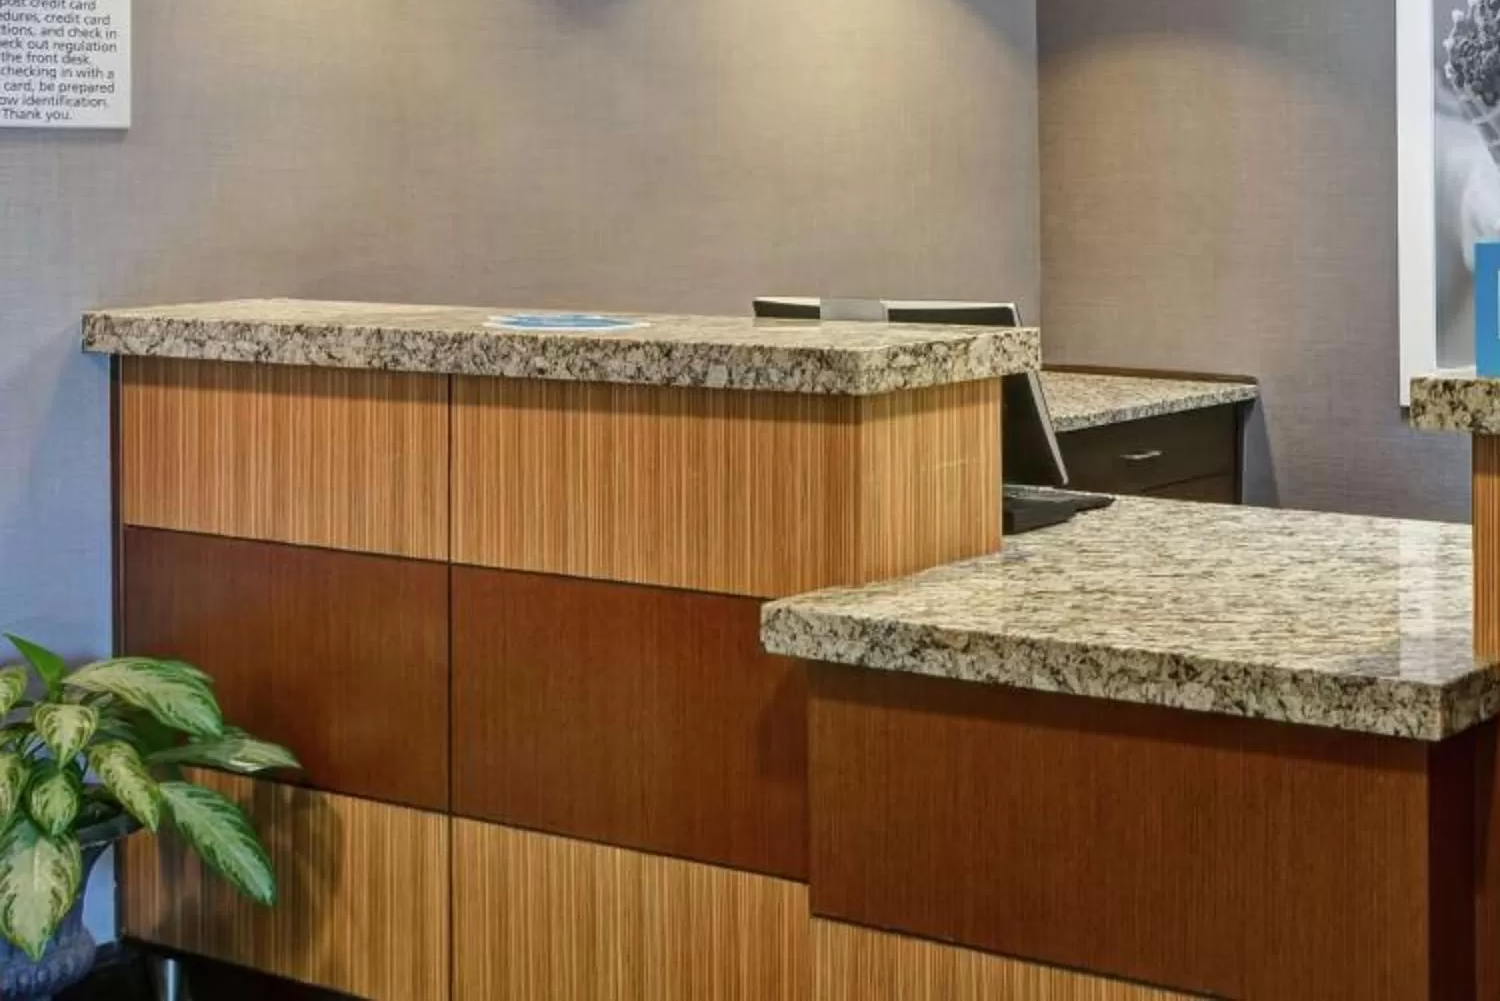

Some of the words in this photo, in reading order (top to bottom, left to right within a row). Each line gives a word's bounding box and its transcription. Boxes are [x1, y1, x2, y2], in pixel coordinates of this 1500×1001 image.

[69, 0, 96, 11] card
[44, 13, 81, 24] credit
[83, 14, 110, 26] card
[41, 25, 65, 37] and
[67, 27, 102, 39] check
[105, 28, 117, 40] in
[27, 39, 49, 50] out
[53, 40, 117, 54] regulation
[27, 51, 58, 64] front
[0, 65, 57, 79] checking
[61, 66, 73, 78] in
[76, 67, 104, 79] with
[106, 70, 115, 80] a
[39, 81, 55, 92] be
[58, 82, 115, 96] prepared
[3, 107, 42, 120] Thank
[45, 109, 73, 122] you.
